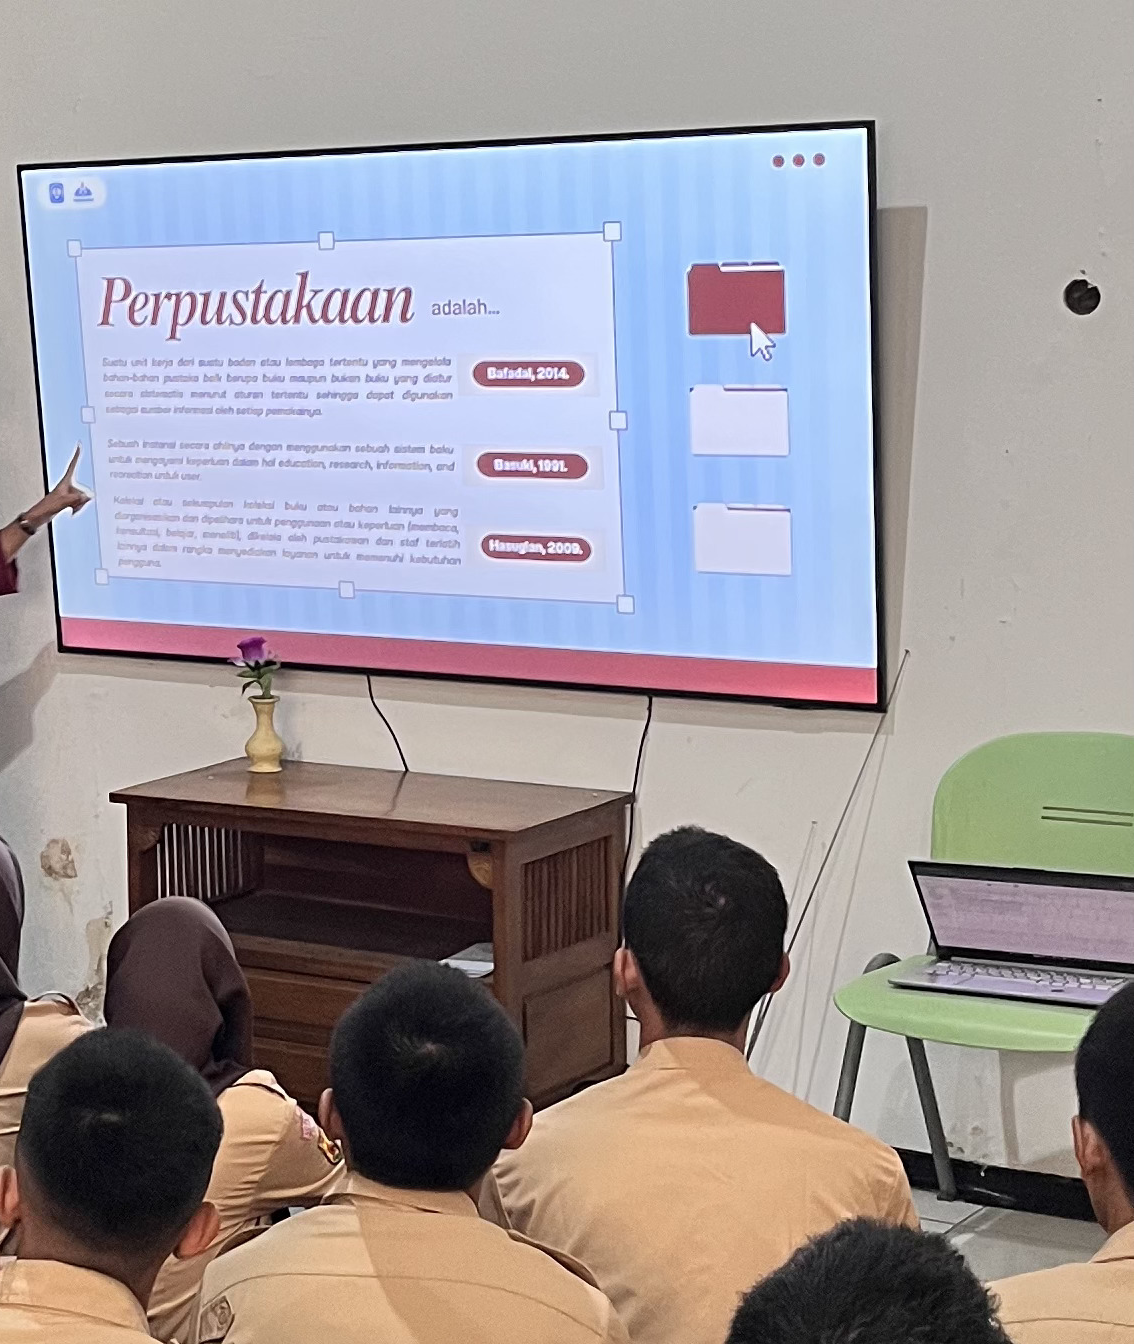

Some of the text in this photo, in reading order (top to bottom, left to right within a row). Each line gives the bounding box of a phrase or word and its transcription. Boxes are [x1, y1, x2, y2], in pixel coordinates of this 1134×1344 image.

[97, 270, 501, 342] Perpustakaan adalah...
[372, 358, 397, 369] yang
